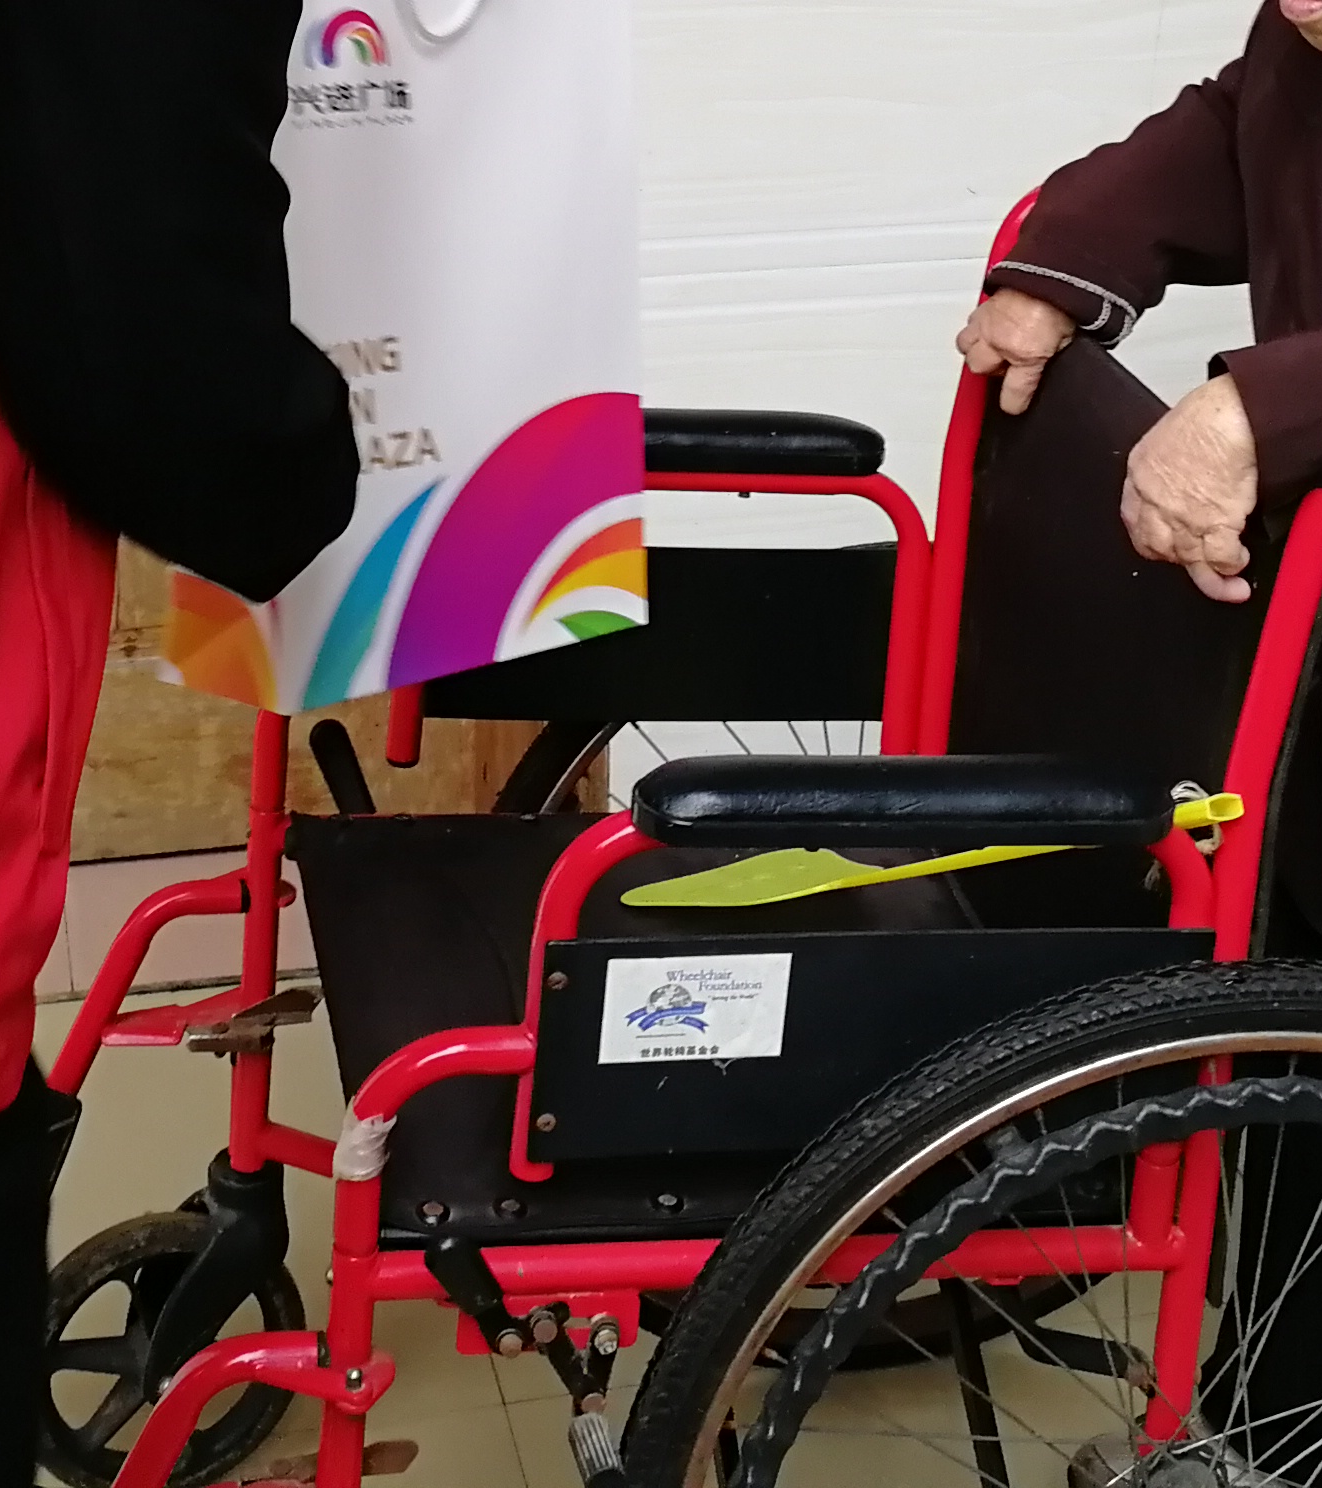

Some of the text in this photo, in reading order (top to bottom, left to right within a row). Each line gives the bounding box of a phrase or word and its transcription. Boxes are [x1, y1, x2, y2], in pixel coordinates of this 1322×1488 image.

[666, 968, 733, 983] Wheelchair
[698, 979, 763, 992] Foundation
[640, 1044, 720, 1058] 世界轮椅基金会
